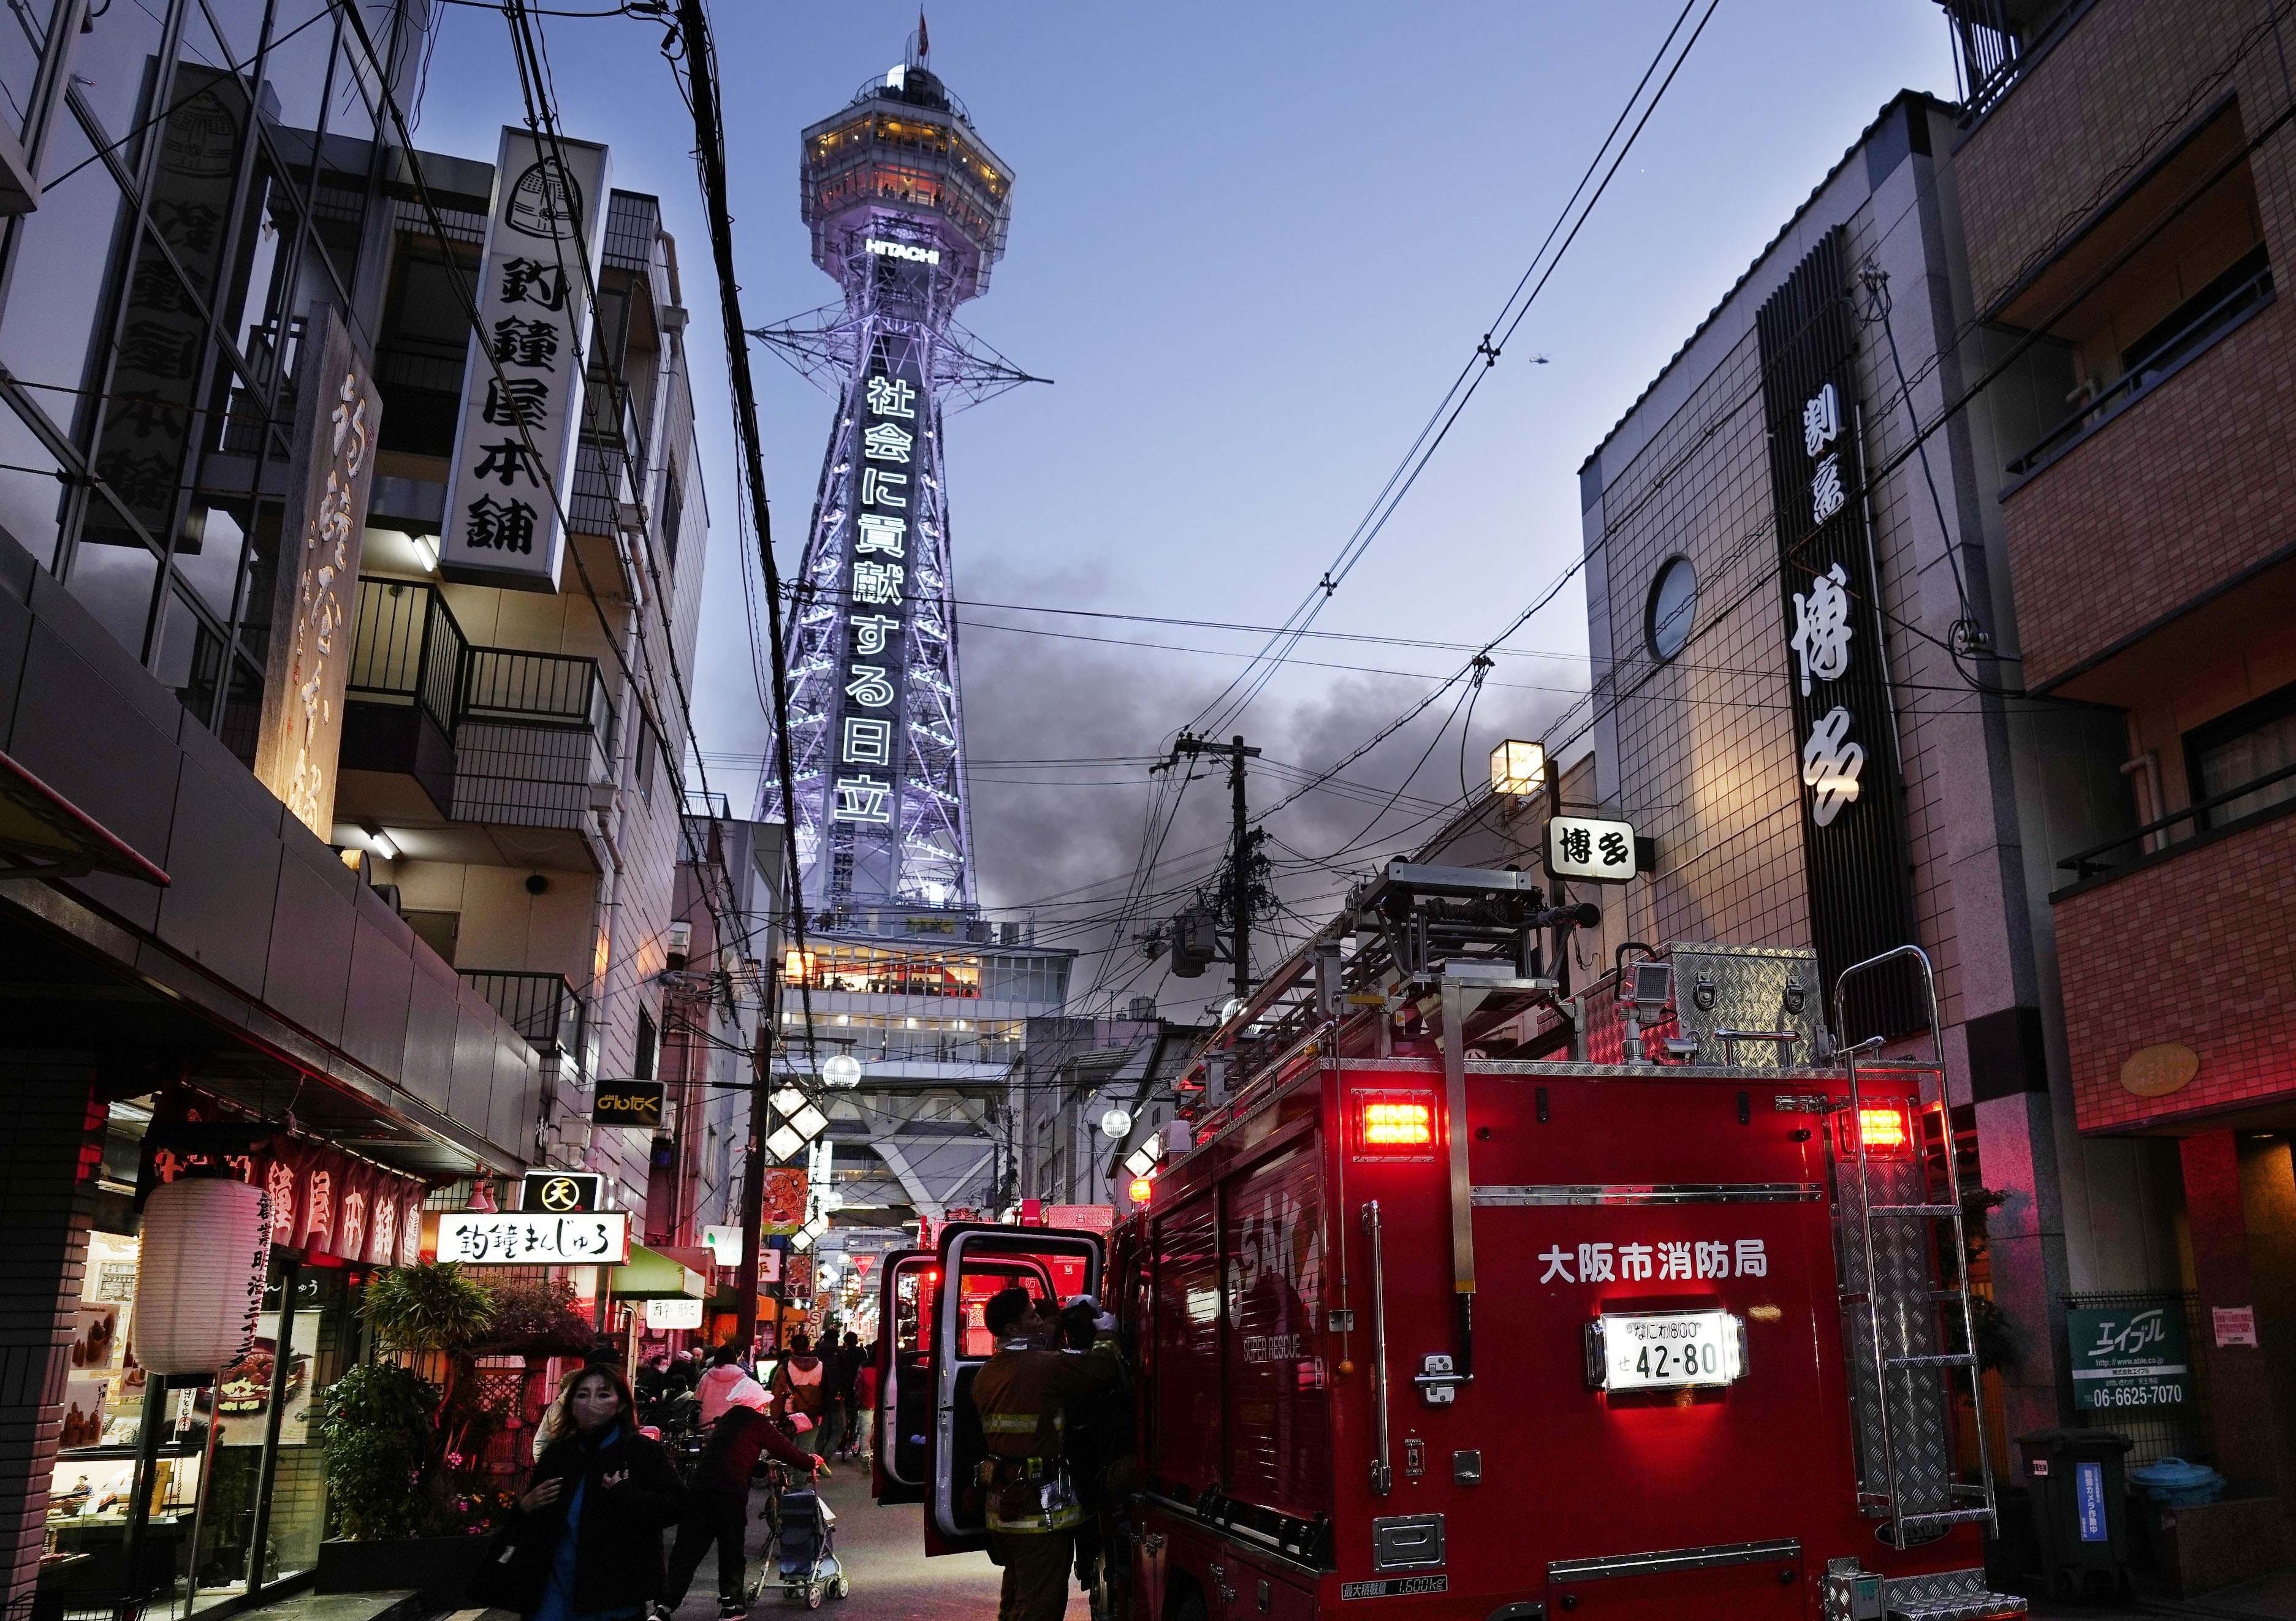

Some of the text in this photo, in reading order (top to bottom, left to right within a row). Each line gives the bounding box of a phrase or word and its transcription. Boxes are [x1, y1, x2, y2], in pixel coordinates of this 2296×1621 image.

[866, 238, 939, 265] HITACHI
[466, 256, 563, 555] 釣鐘屋本舗
[834, 376, 916, 823] 社会に貢献する日立
[1790, 562, 1865, 828] 博多
[1559, 827, 1629, 866] 博多
[597, 1095, 660, 1112] どんたく
[1228, 1191, 1320, 1334] OSAKA
[1538, 1239, 1768, 1284] 大阪市消防局
[1244, 1334, 1301, 1362] SUPER RESCUE
[2088, 1309, 2165, 1356] エイブル
[1636, 1343, 1717, 1378] 42-80
[2094, 1384, 2182, 1408] 06-6625-7070
[1344, 1582, 1387, 1598] 最大積載量
